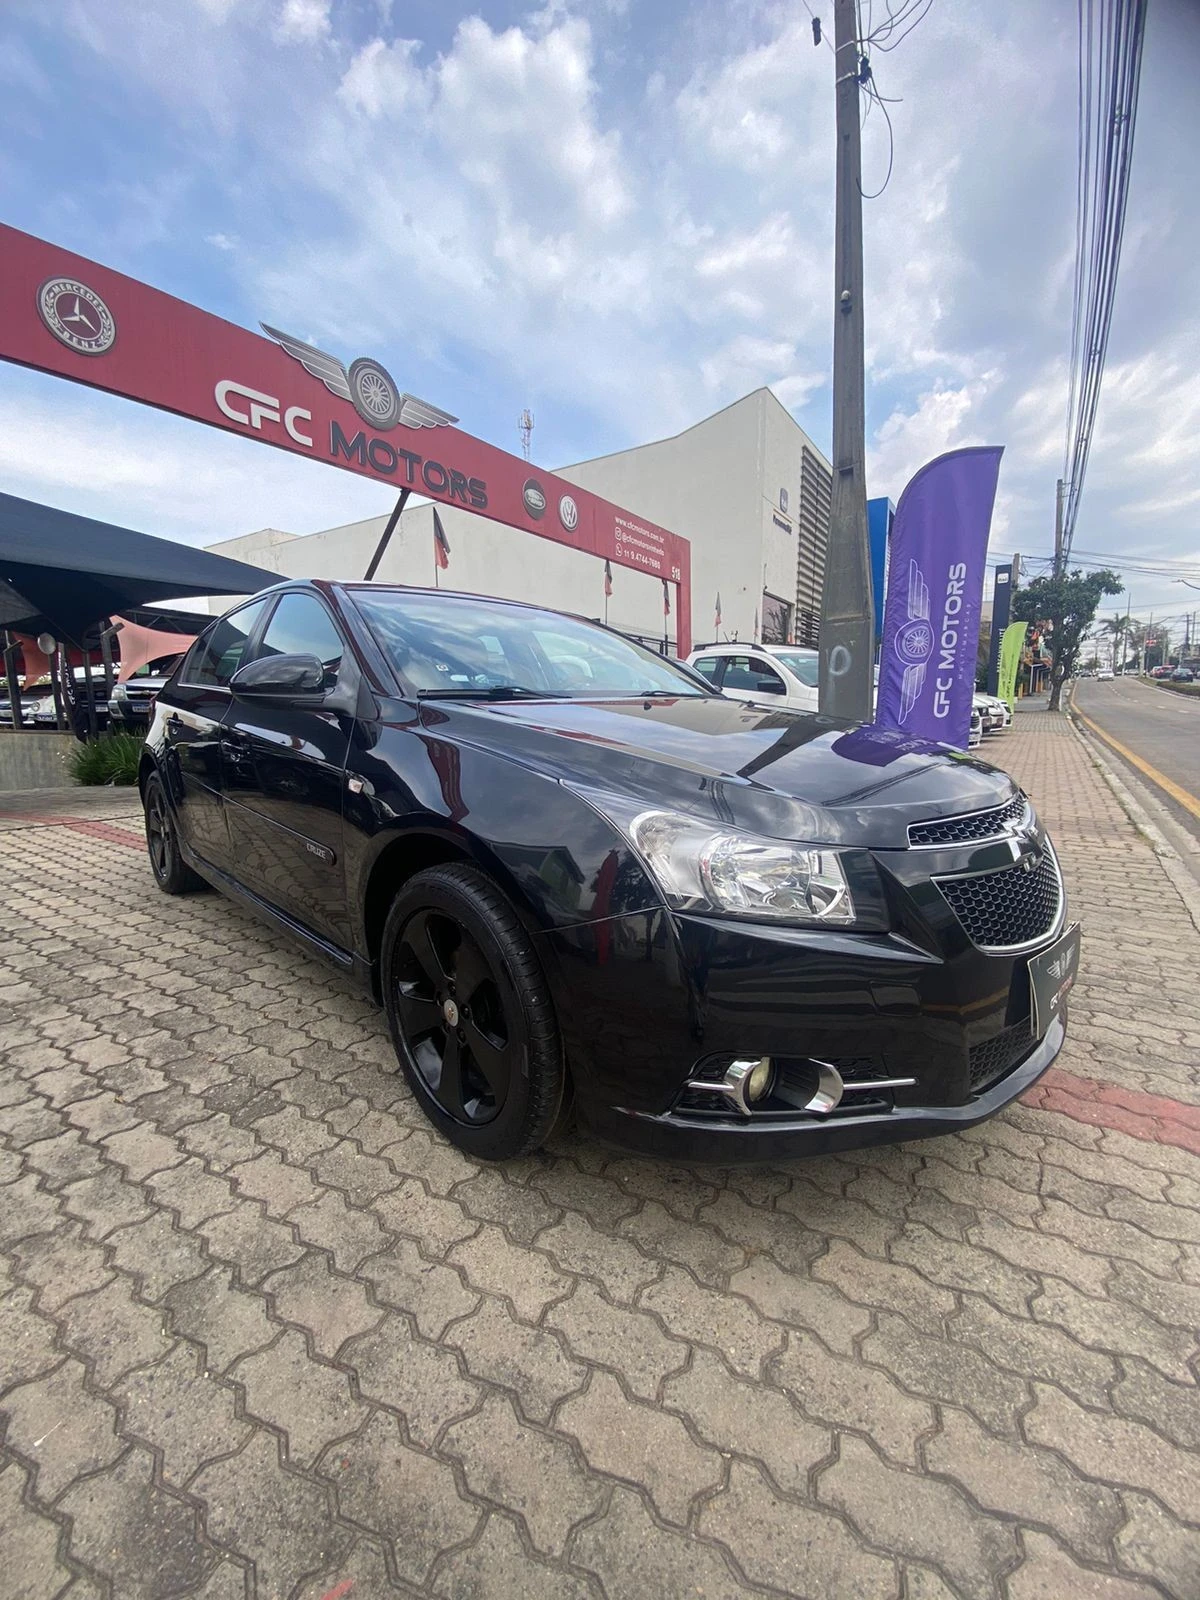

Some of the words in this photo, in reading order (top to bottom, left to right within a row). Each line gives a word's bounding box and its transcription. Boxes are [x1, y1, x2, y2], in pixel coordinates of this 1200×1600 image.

[52, 283, 104, 313] MERCEDES
[62, 330, 98, 349] BENZ
[214, 380, 313, 447] CFC
[329, 419, 489, 509] MOTORS
[938, 562, 967, 670] MOTORS
[933, 677, 953, 718] CFC
[306, 843, 326, 859] CRUZE
